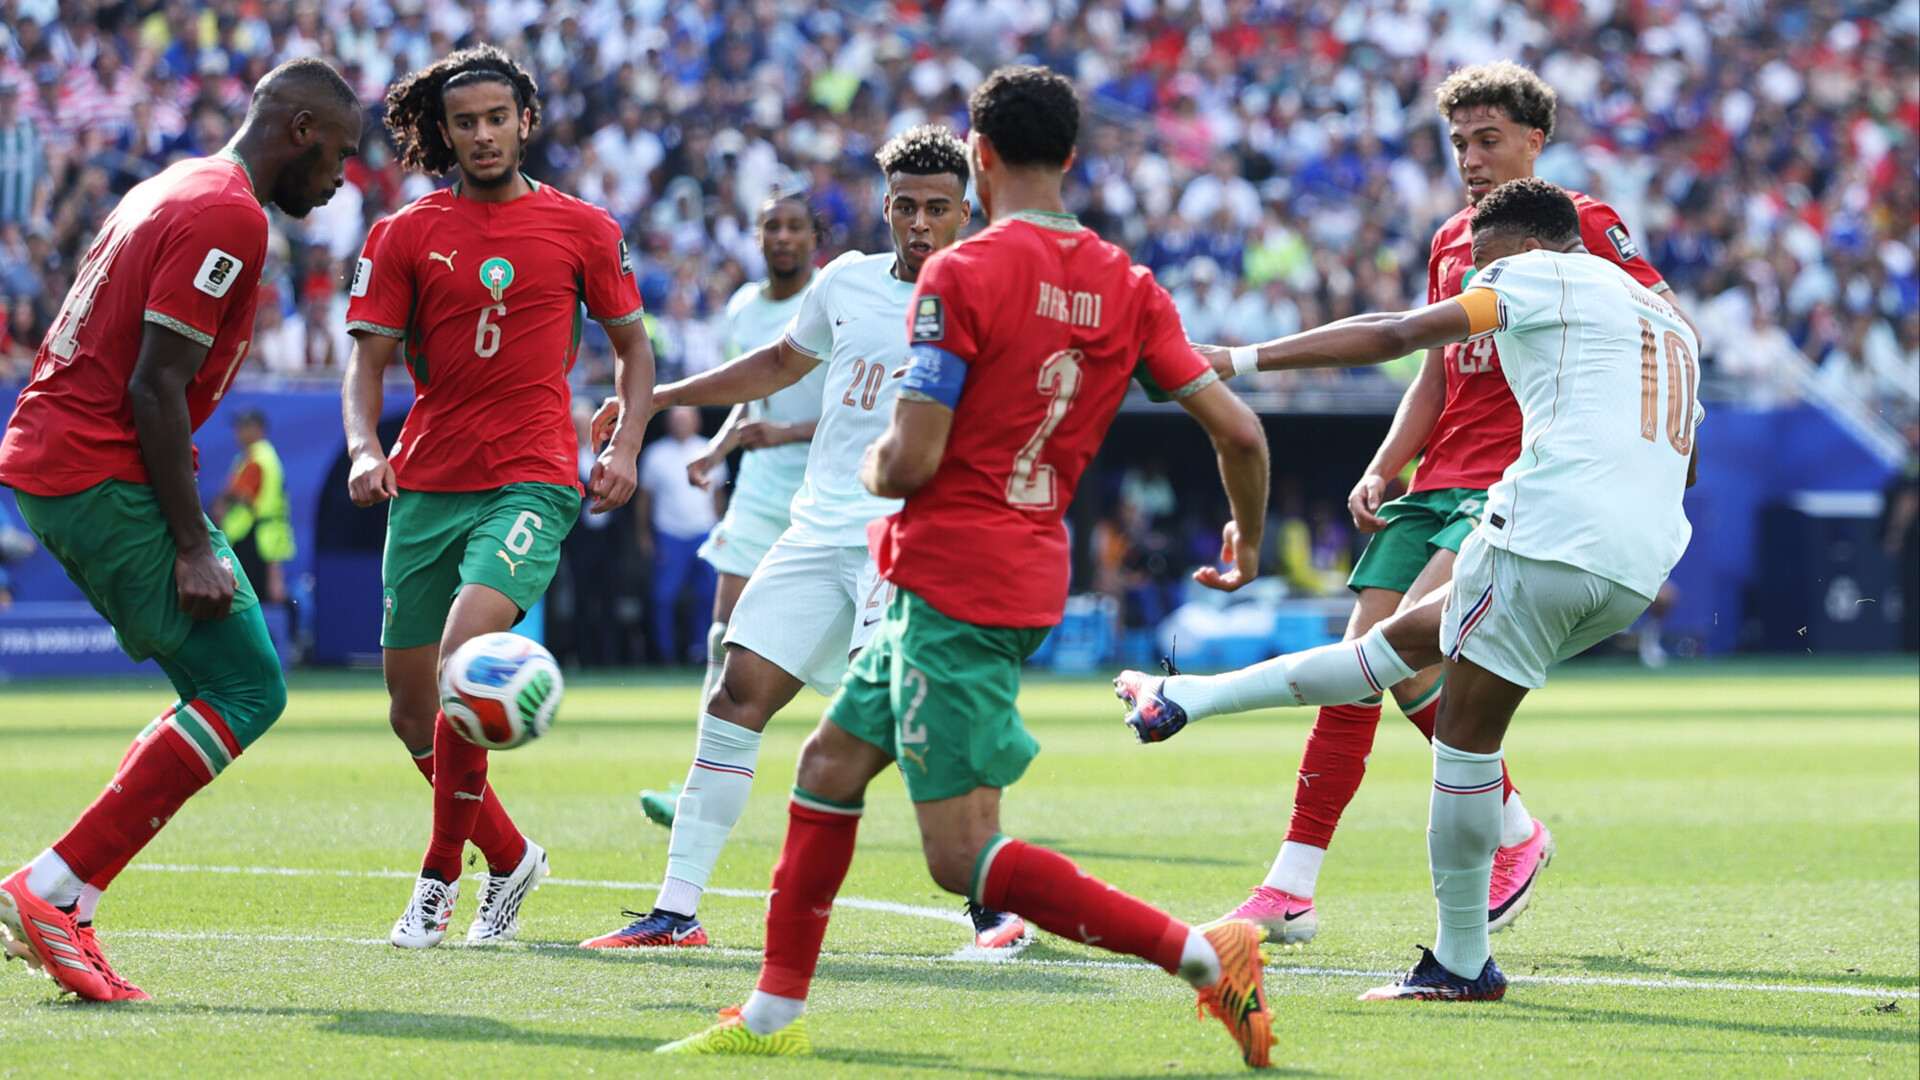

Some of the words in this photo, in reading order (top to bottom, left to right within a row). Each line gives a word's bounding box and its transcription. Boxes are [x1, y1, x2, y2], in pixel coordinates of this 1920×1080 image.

[474, 302, 507, 358] 6
[1036, 281, 1102, 328] HAKMI
[842, 359, 885, 411] 20
[1639, 316, 1696, 456] 10
[1007, 348, 1084, 511] 2
[505, 511, 543, 556] 6
[902, 668, 928, 744] 2
